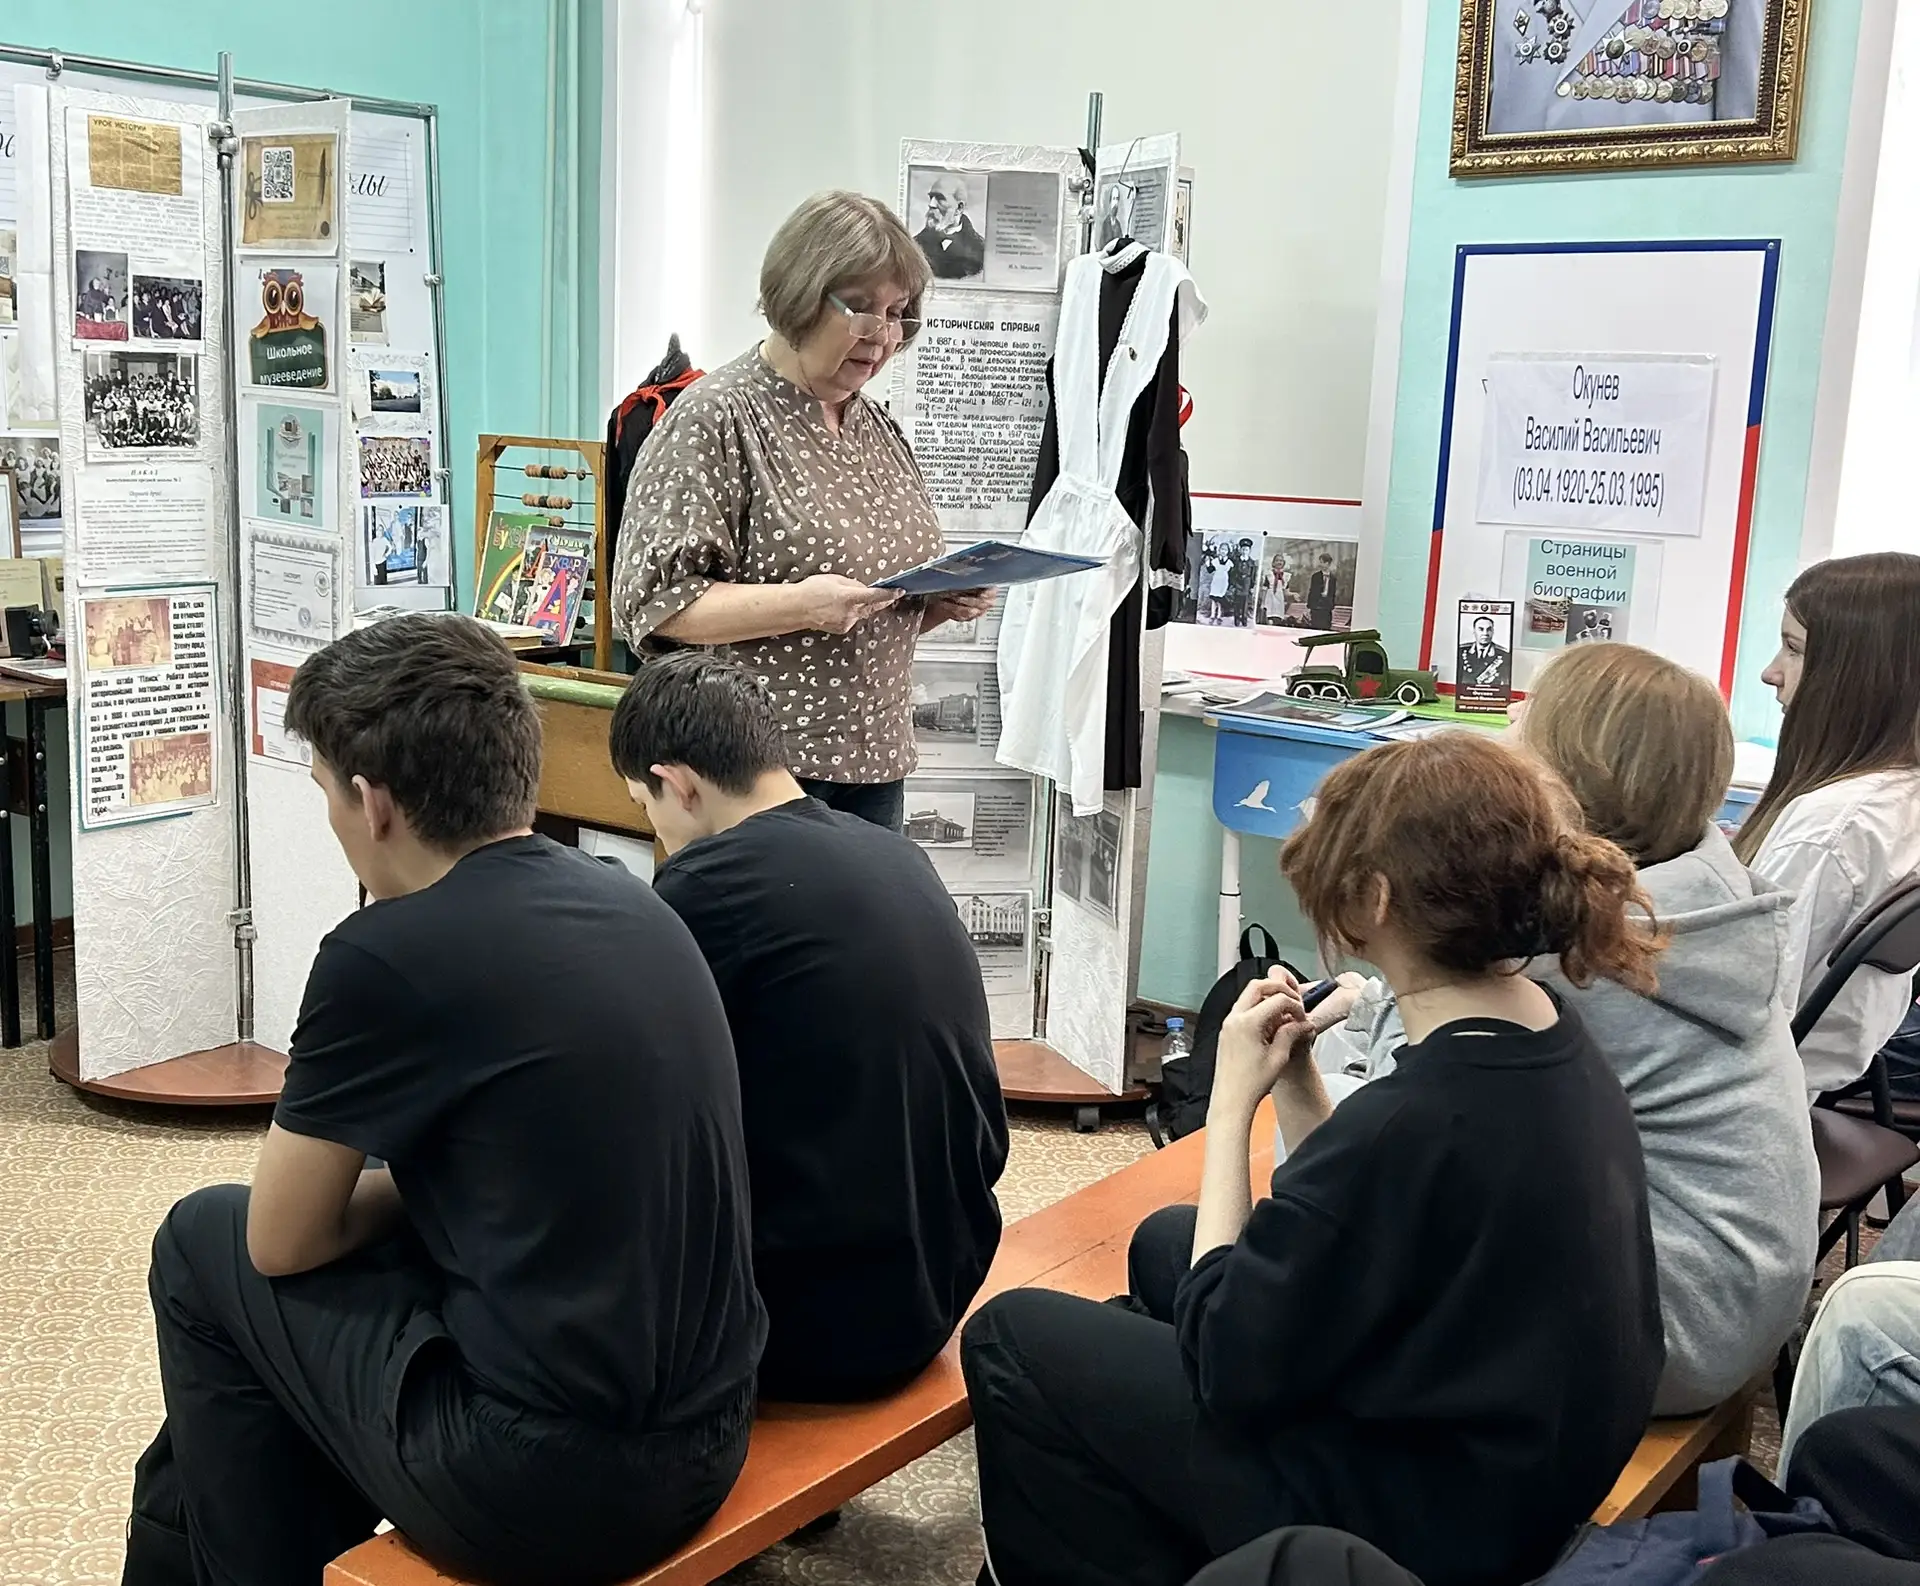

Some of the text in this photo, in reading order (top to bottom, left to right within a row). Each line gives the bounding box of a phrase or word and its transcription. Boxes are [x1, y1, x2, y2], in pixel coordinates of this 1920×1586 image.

[93, 119, 113, 127] УРОК
[927, 318, 1040, 332] ИСТОРИЧЕСКАЯ СПРАВКА
[266, 344, 313, 360] Школьное
[944, 347, 976, 355] женское
[260, 367, 322, 386] музееведение
[1573, 365, 1620, 409] Окунев
[1525, 415, 1662, 455] Василий Васильевич
[1512, 466, 1665, 517] (03.04.1920-25.03.1995)
[1540, 539, 1627, 560] Страницы
[1545, 563, 1617, 580] военной
[1532, 581, 1627, 604] биографии
